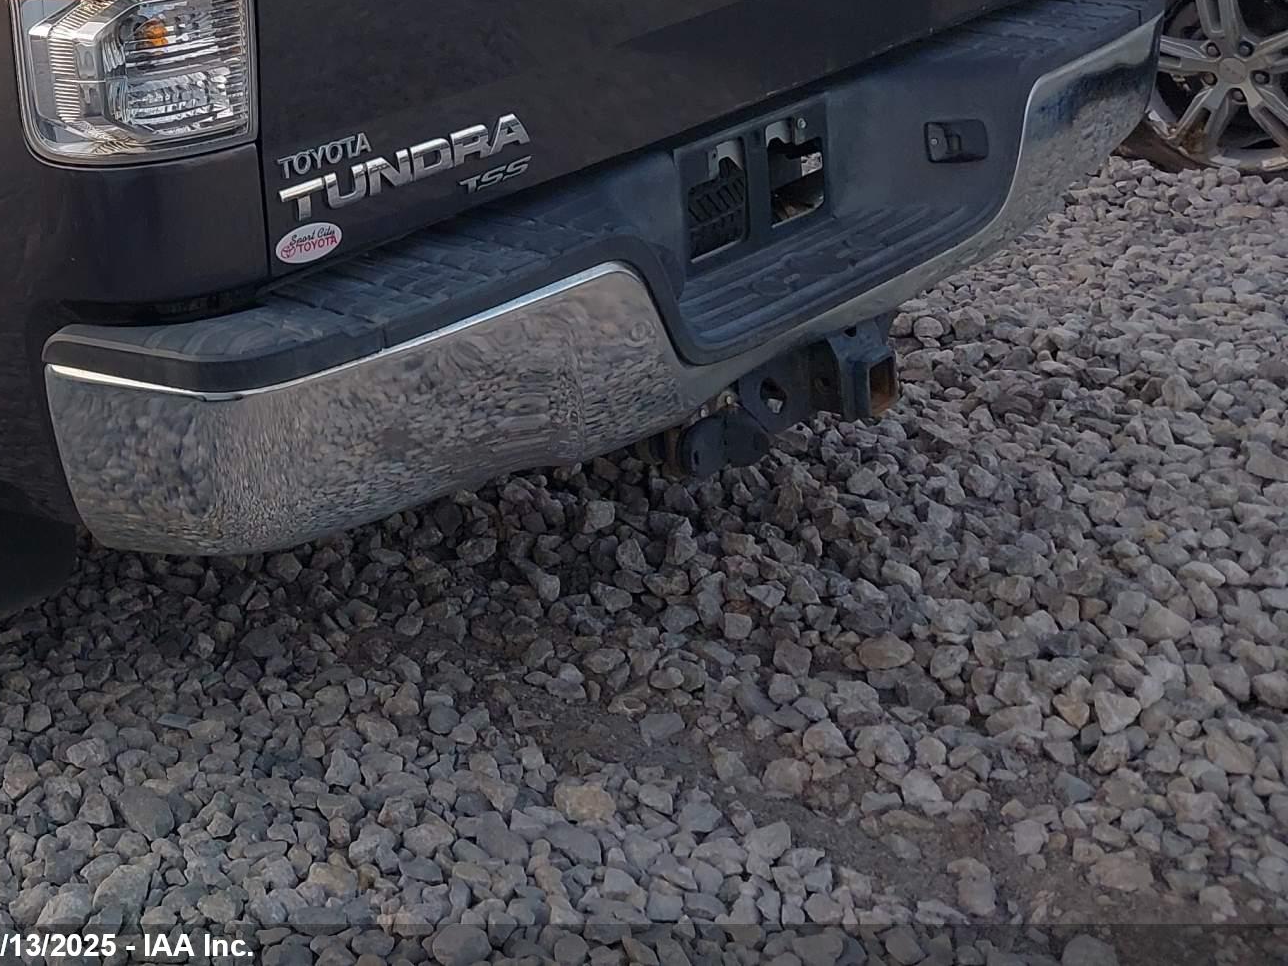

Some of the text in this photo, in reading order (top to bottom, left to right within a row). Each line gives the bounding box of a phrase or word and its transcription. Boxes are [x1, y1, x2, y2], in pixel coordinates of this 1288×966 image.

[277, 132, 372, 179] TOYOTA
[278, 113, 532, 222] TUNDRA
[459, 155, 532, 195] TSS
[296, 235, 338, 253] TOYOTA
